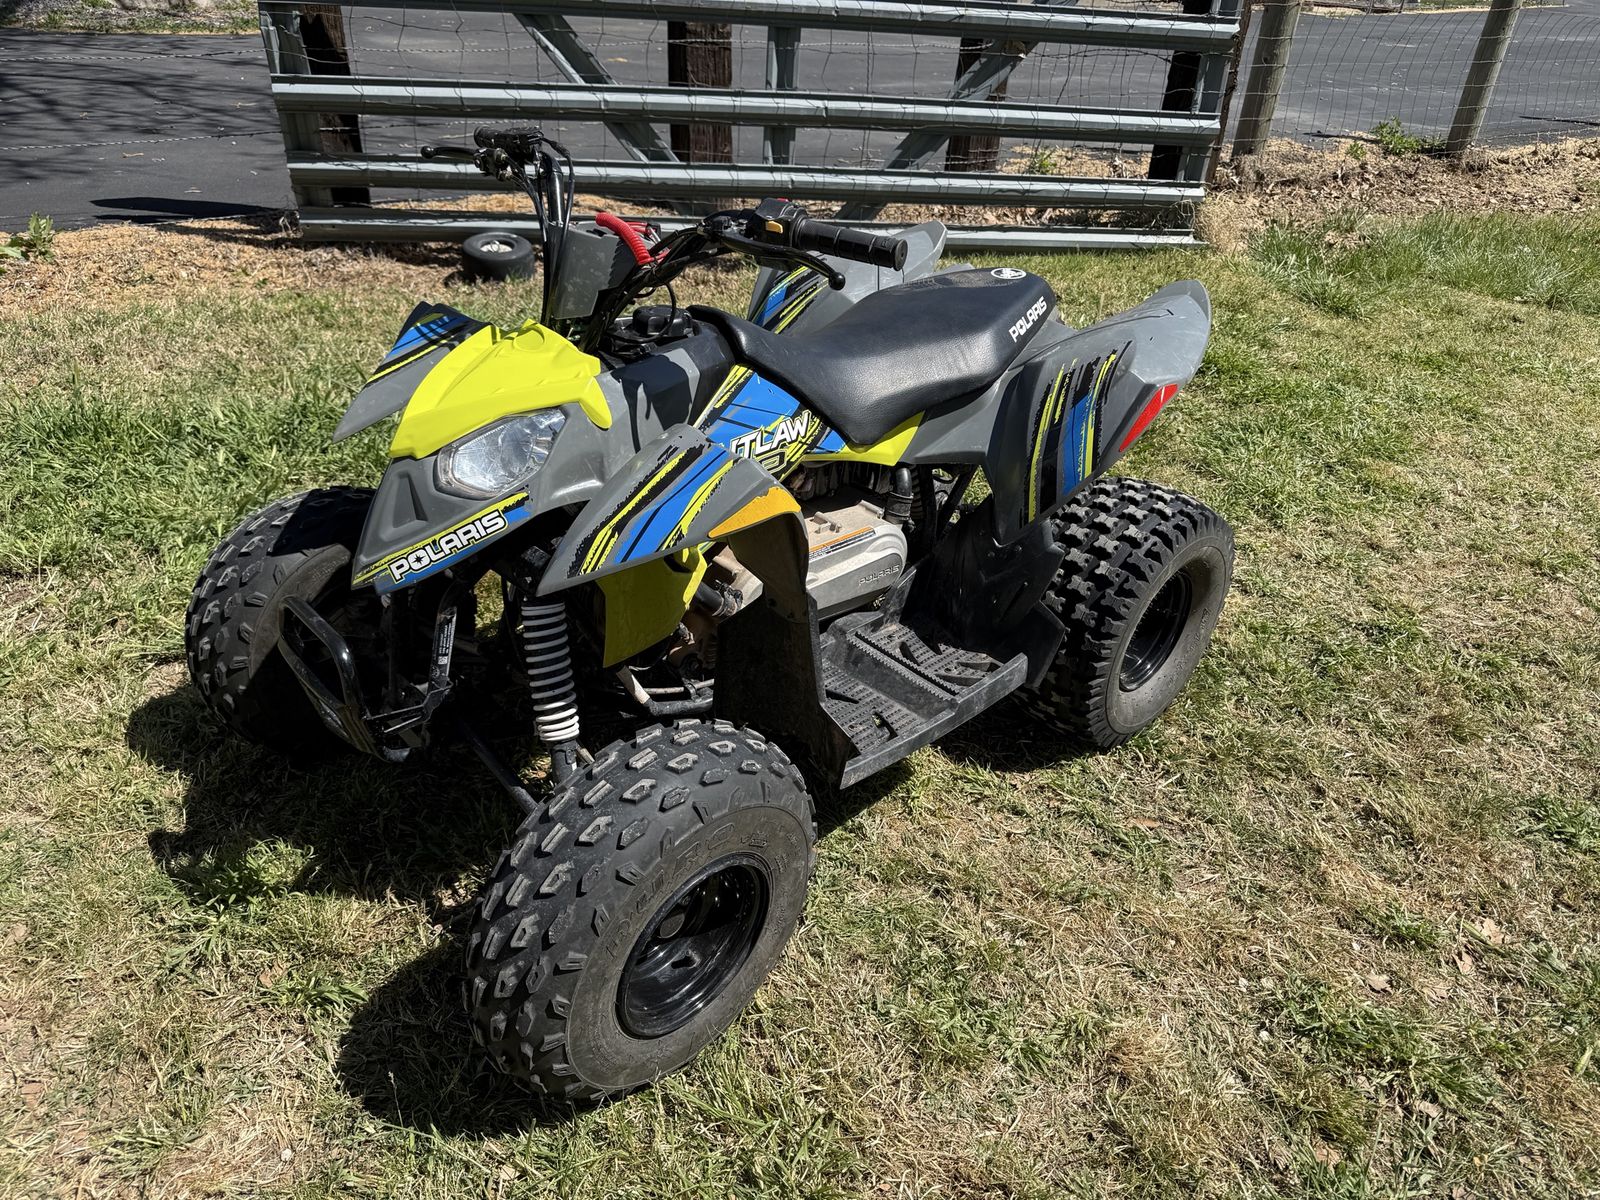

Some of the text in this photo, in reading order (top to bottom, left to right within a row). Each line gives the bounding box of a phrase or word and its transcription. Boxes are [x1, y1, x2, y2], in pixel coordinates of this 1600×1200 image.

[1008, 296, 1048, 343] POLARIS
[388, 510, 507, 581] POLARIS
[858, 564, 900, 586] POLARIS
